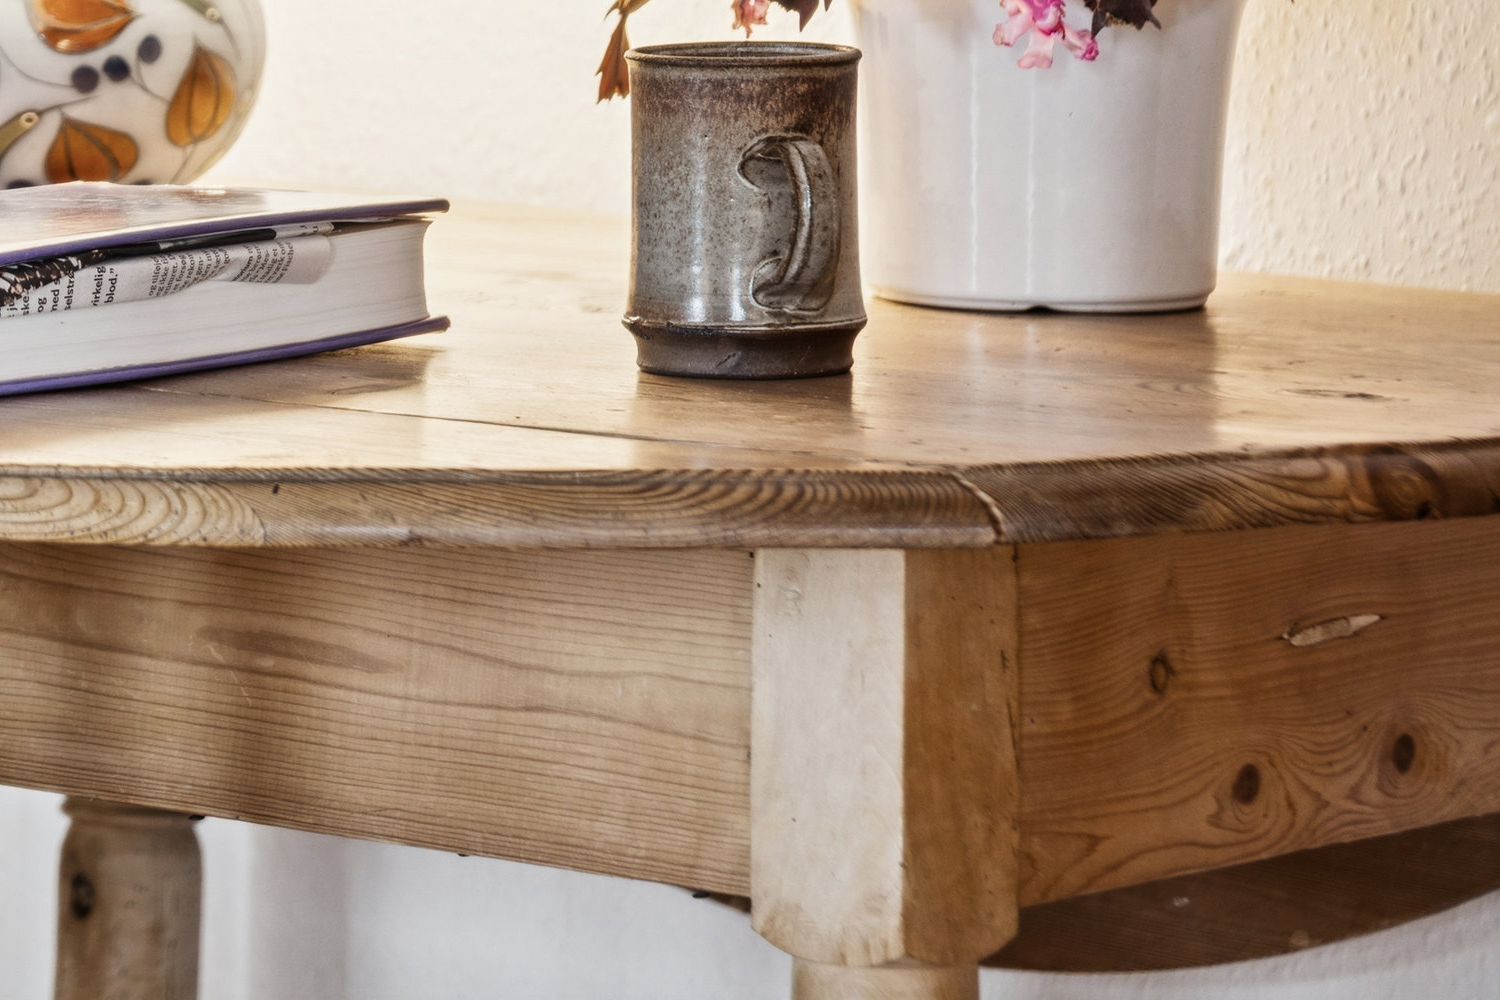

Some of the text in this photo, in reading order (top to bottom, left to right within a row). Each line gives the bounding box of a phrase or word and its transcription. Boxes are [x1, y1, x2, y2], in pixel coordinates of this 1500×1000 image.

[158, 267, 169, 285] ikke
[149, 285, 157, 296] og
[38, 297, 47, 313] og
